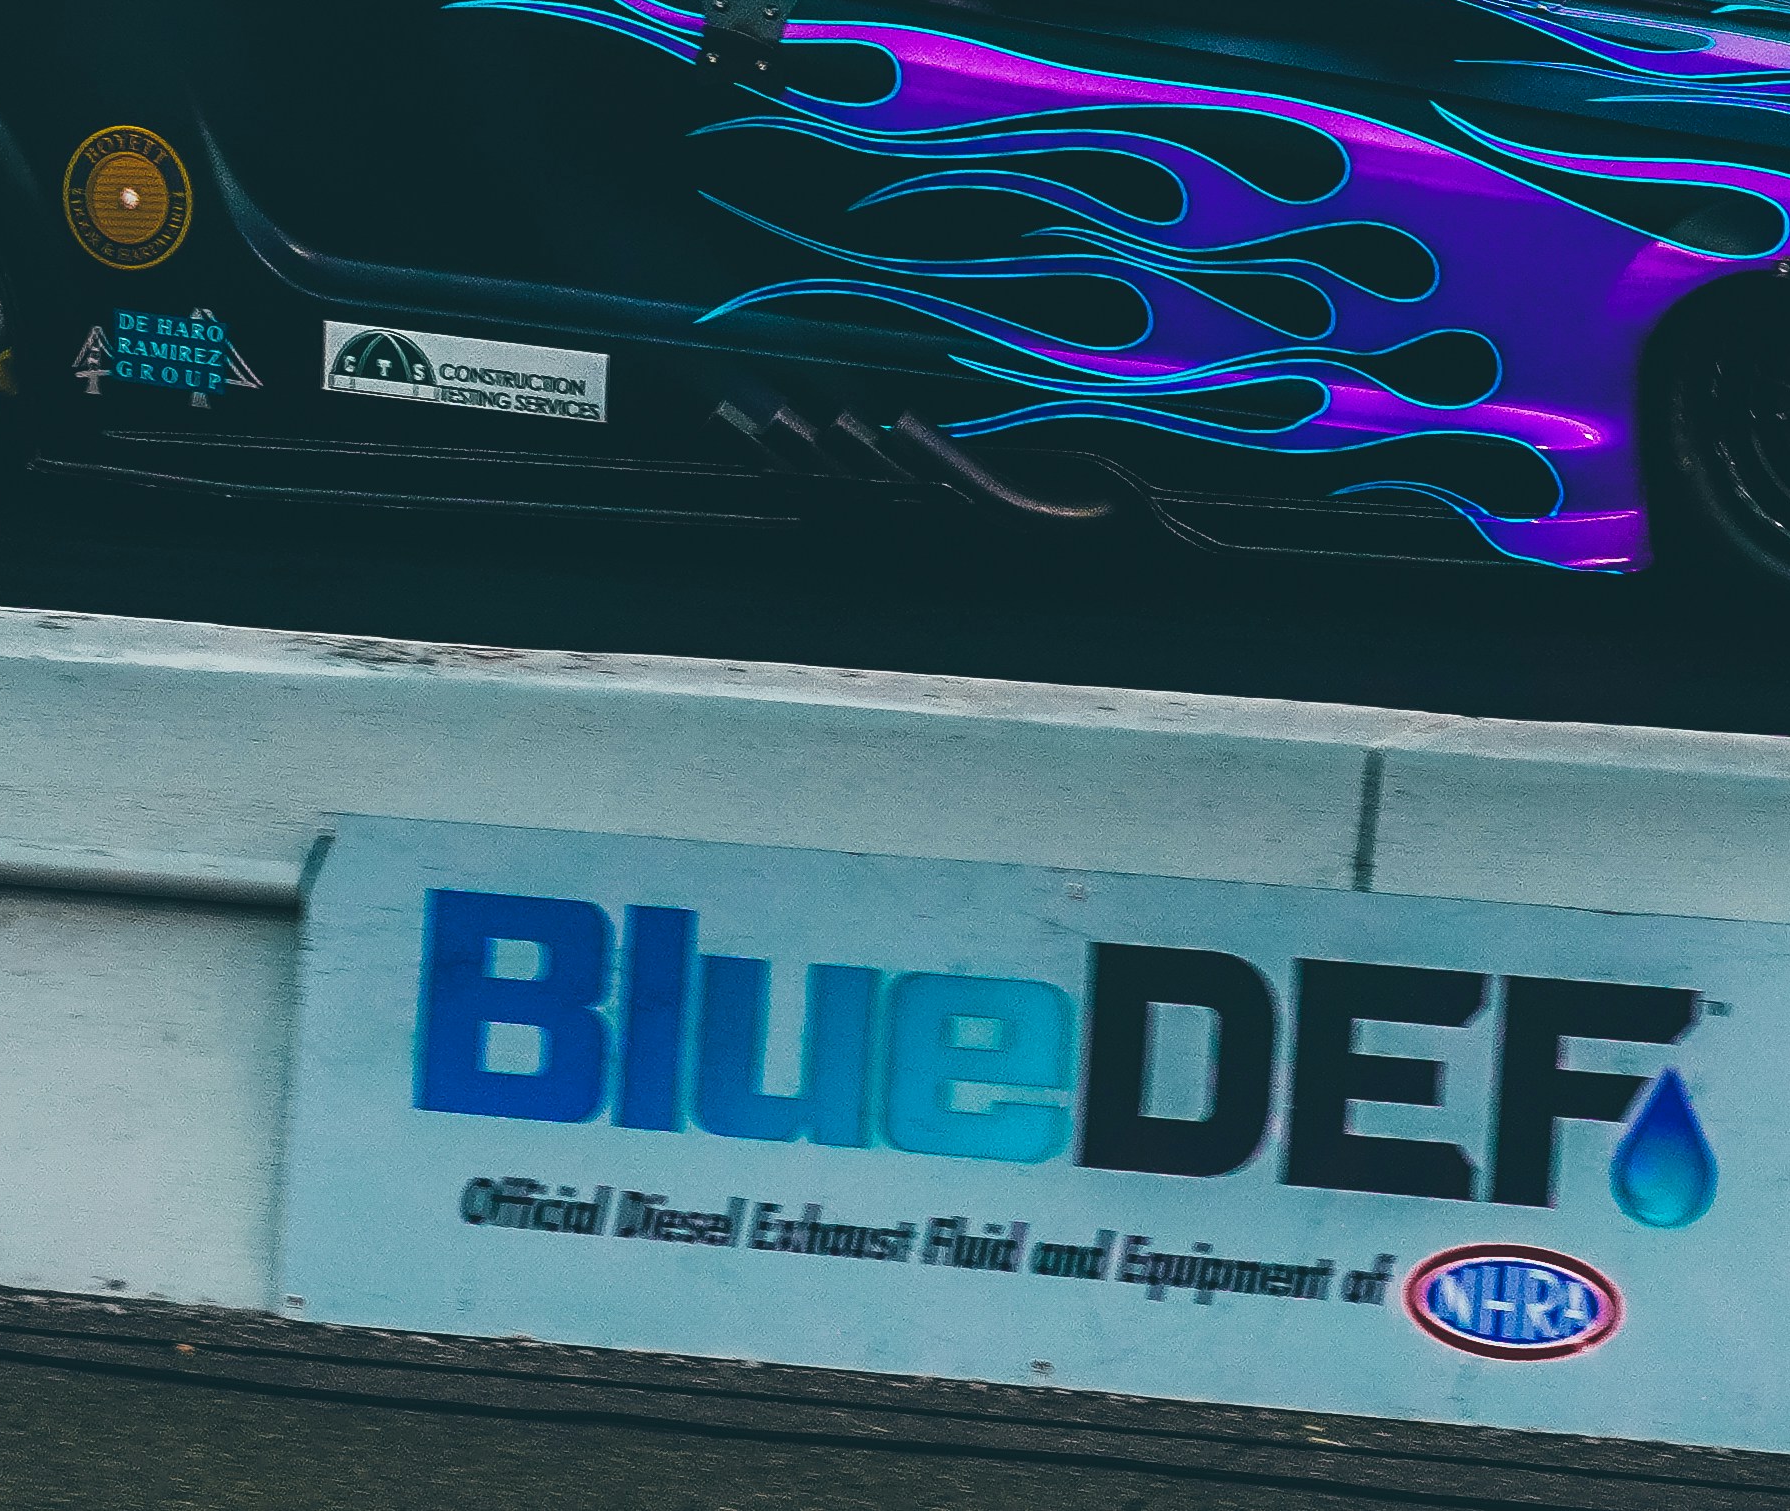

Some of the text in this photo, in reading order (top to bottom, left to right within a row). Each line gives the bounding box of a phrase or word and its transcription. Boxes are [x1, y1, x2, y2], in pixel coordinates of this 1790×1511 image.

[118, 313, 224, 343] DE HARO
[117, 337, 223, 367] RAMIREZ
[115, 360, 222, 390] GROUP
[439, 363, 586, 396] CONSTRUCTION
[440, 386, 600, 420] TESTING SERVICES
[414, 888, 1703, 1210] BlueDEF
[459, 1176, 1397, 1305] Official Diesel Exhaust Fluid and Equipment of
[1424, 1258, 1603, 1346] NHRA
